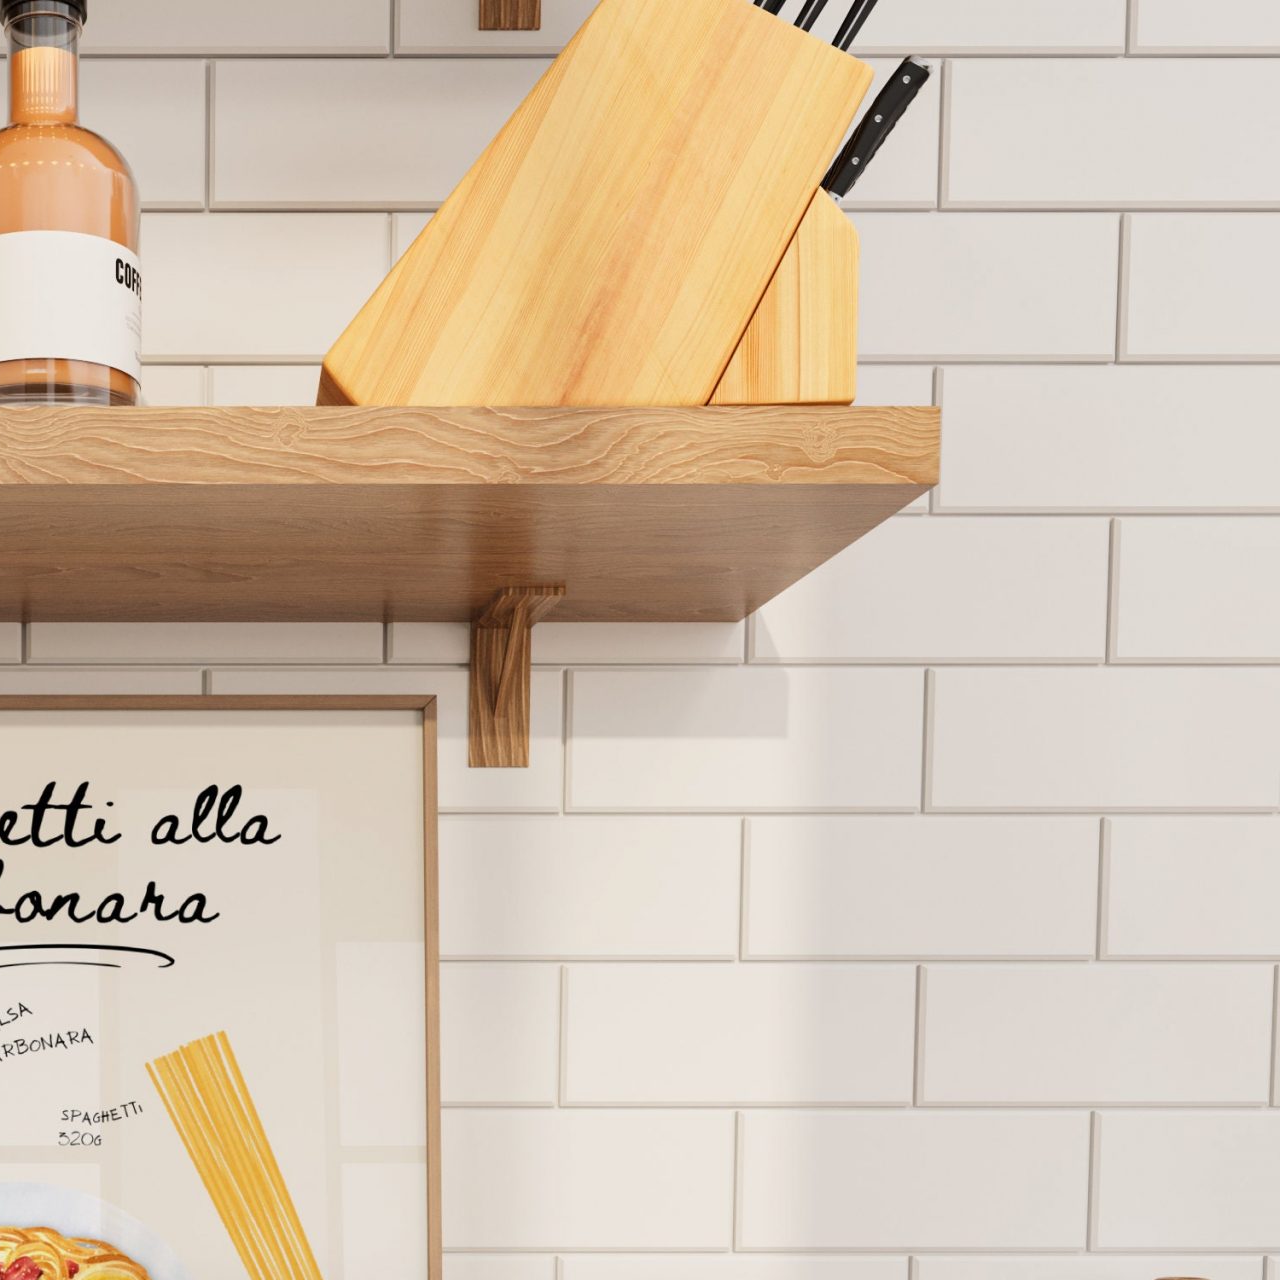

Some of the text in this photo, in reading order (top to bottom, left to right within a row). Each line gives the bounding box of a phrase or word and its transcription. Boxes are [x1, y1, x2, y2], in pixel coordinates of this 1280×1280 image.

[151, 784, 281, 845] alla
[61, 1101, 143, 1126] SPAGHETTI
[58, 1131, 102, 1146] 320G
